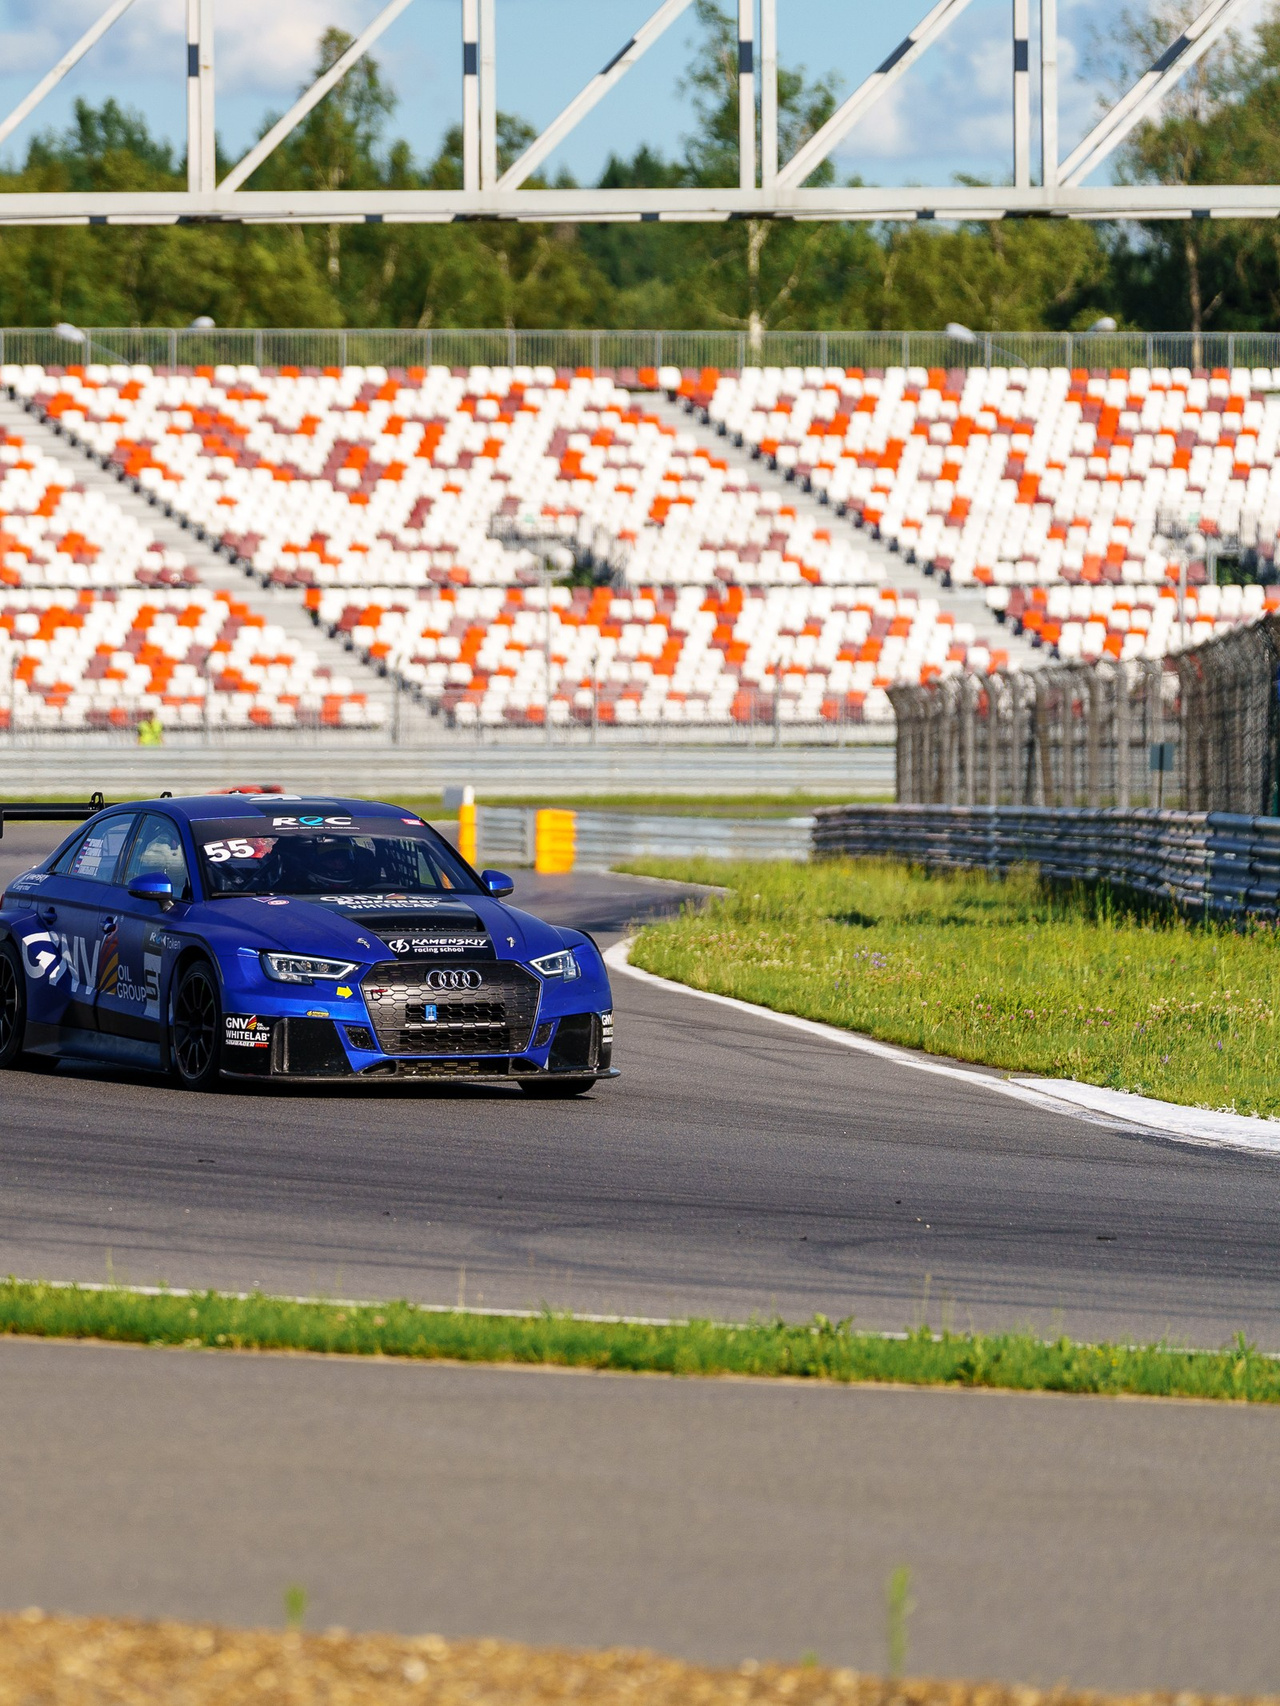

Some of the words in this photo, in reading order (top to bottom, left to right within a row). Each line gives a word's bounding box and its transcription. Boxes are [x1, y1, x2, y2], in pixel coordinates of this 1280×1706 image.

[204, 838, 255, 863] 55
[411, 938, 487, 947] KAMENSKIY
[21, 930, 101, 995] GNV
[117, 964, 132, 982] OIL
[116, 983, 147, 1002] GROUP
[225, 1016, 249, 1030] GNV
